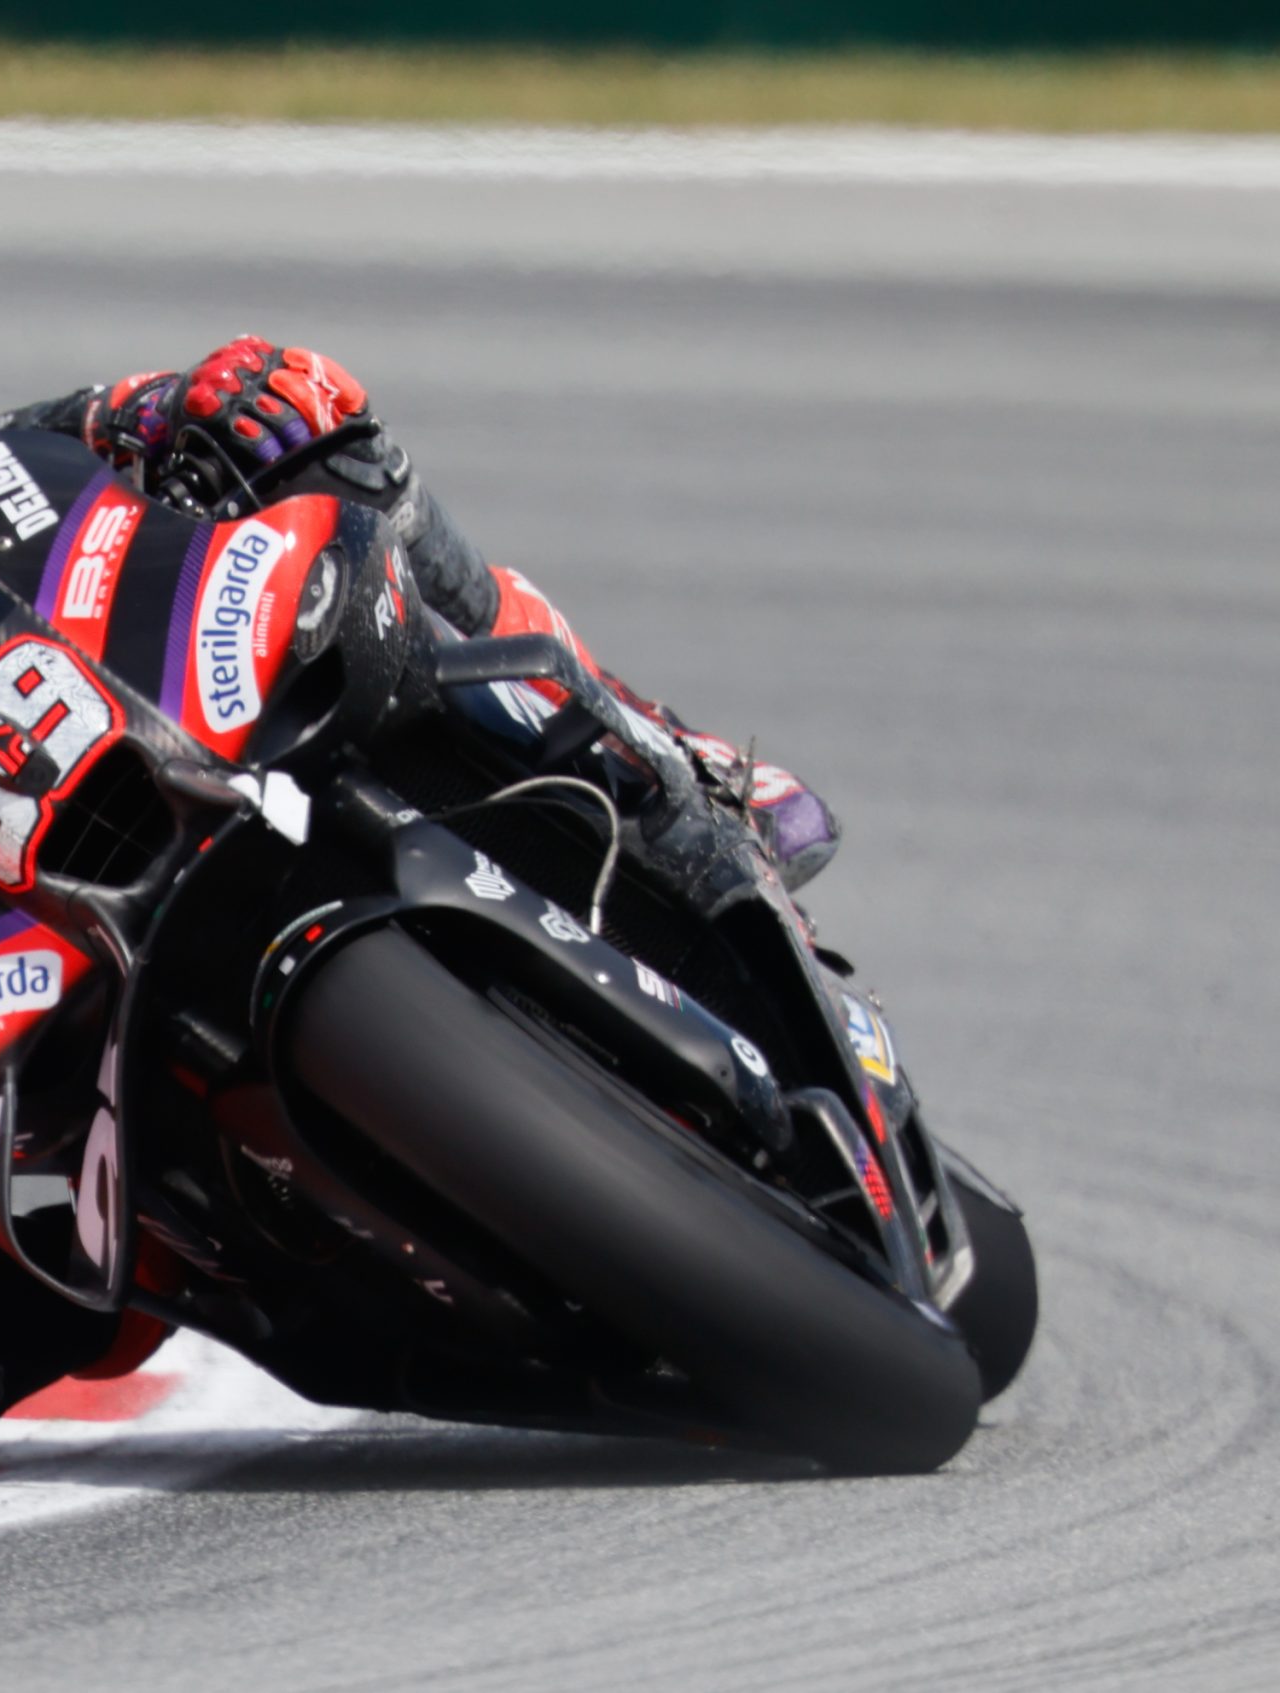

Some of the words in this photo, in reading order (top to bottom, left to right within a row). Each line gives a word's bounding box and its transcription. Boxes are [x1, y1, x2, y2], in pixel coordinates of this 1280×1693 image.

[62, 505, 128, 618] BS
[94, 505, 138, 619] BATTERY
[202, 534, 269, 718] sterilgarda
[254, 592, 276, 657] alimenti
